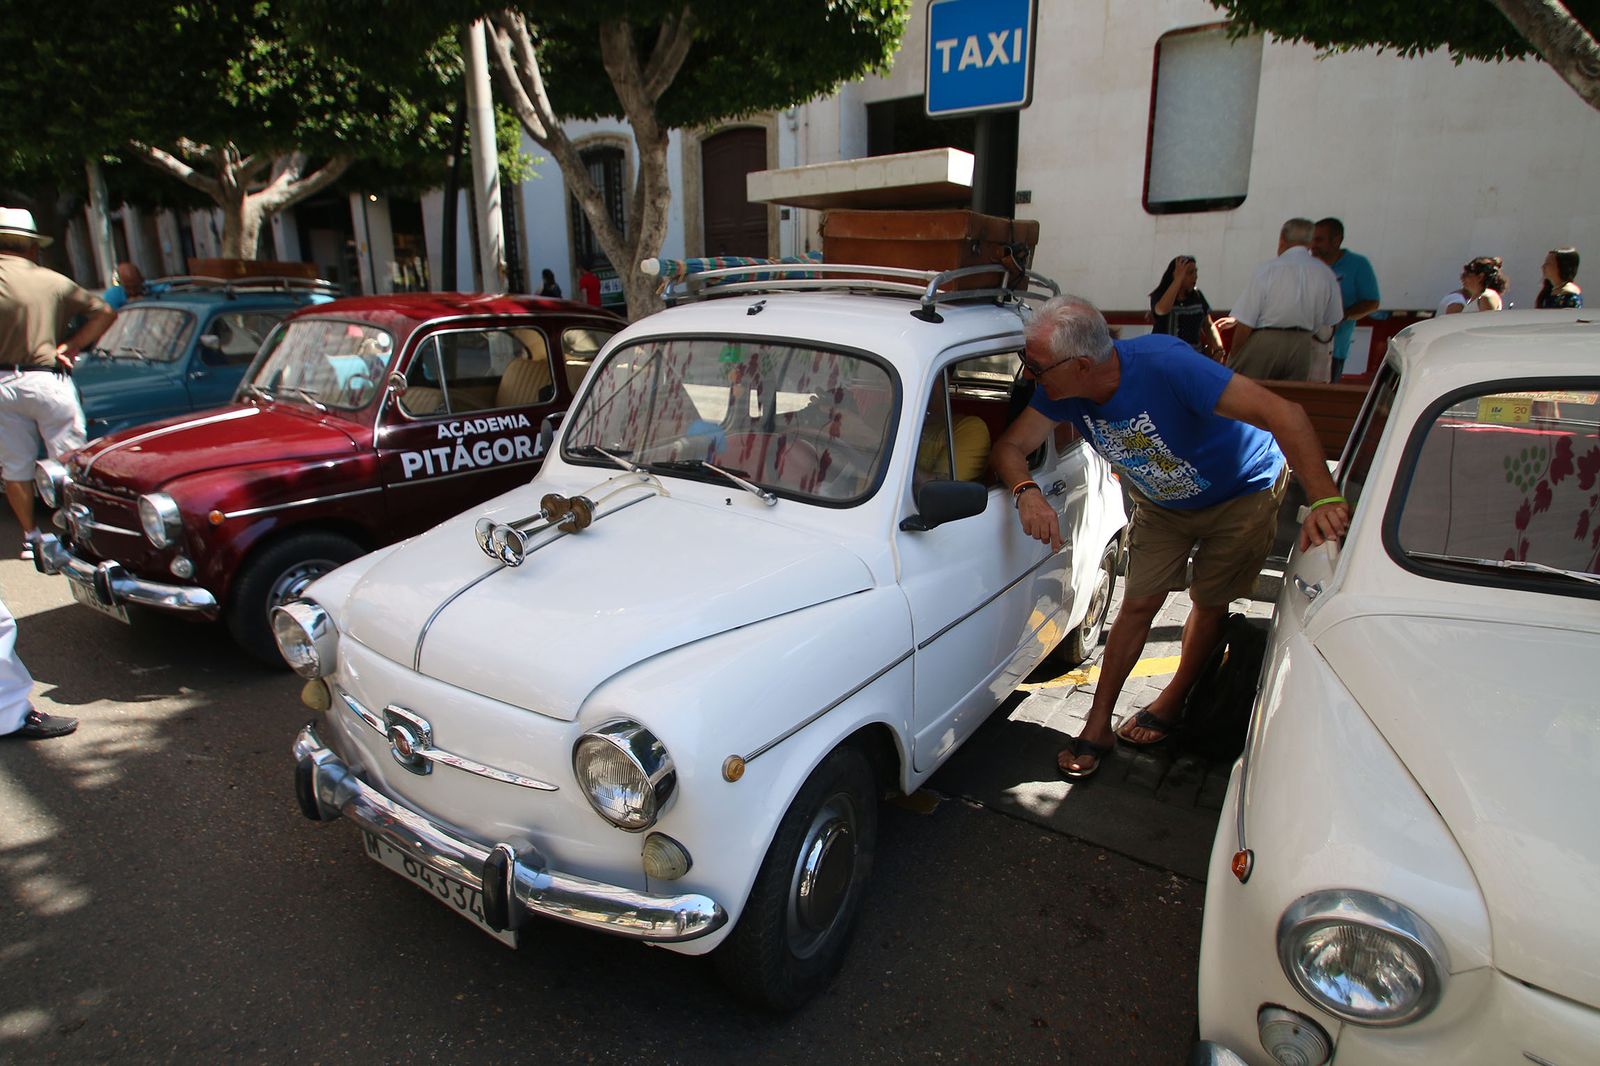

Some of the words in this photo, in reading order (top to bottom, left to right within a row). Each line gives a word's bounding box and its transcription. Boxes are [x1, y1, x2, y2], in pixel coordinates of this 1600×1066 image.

[935, 28, 1022, 74] TAXI
[437, 414, 531, 440] ACADEMIA
[400, 430, 556, 479] PITÁGORA
